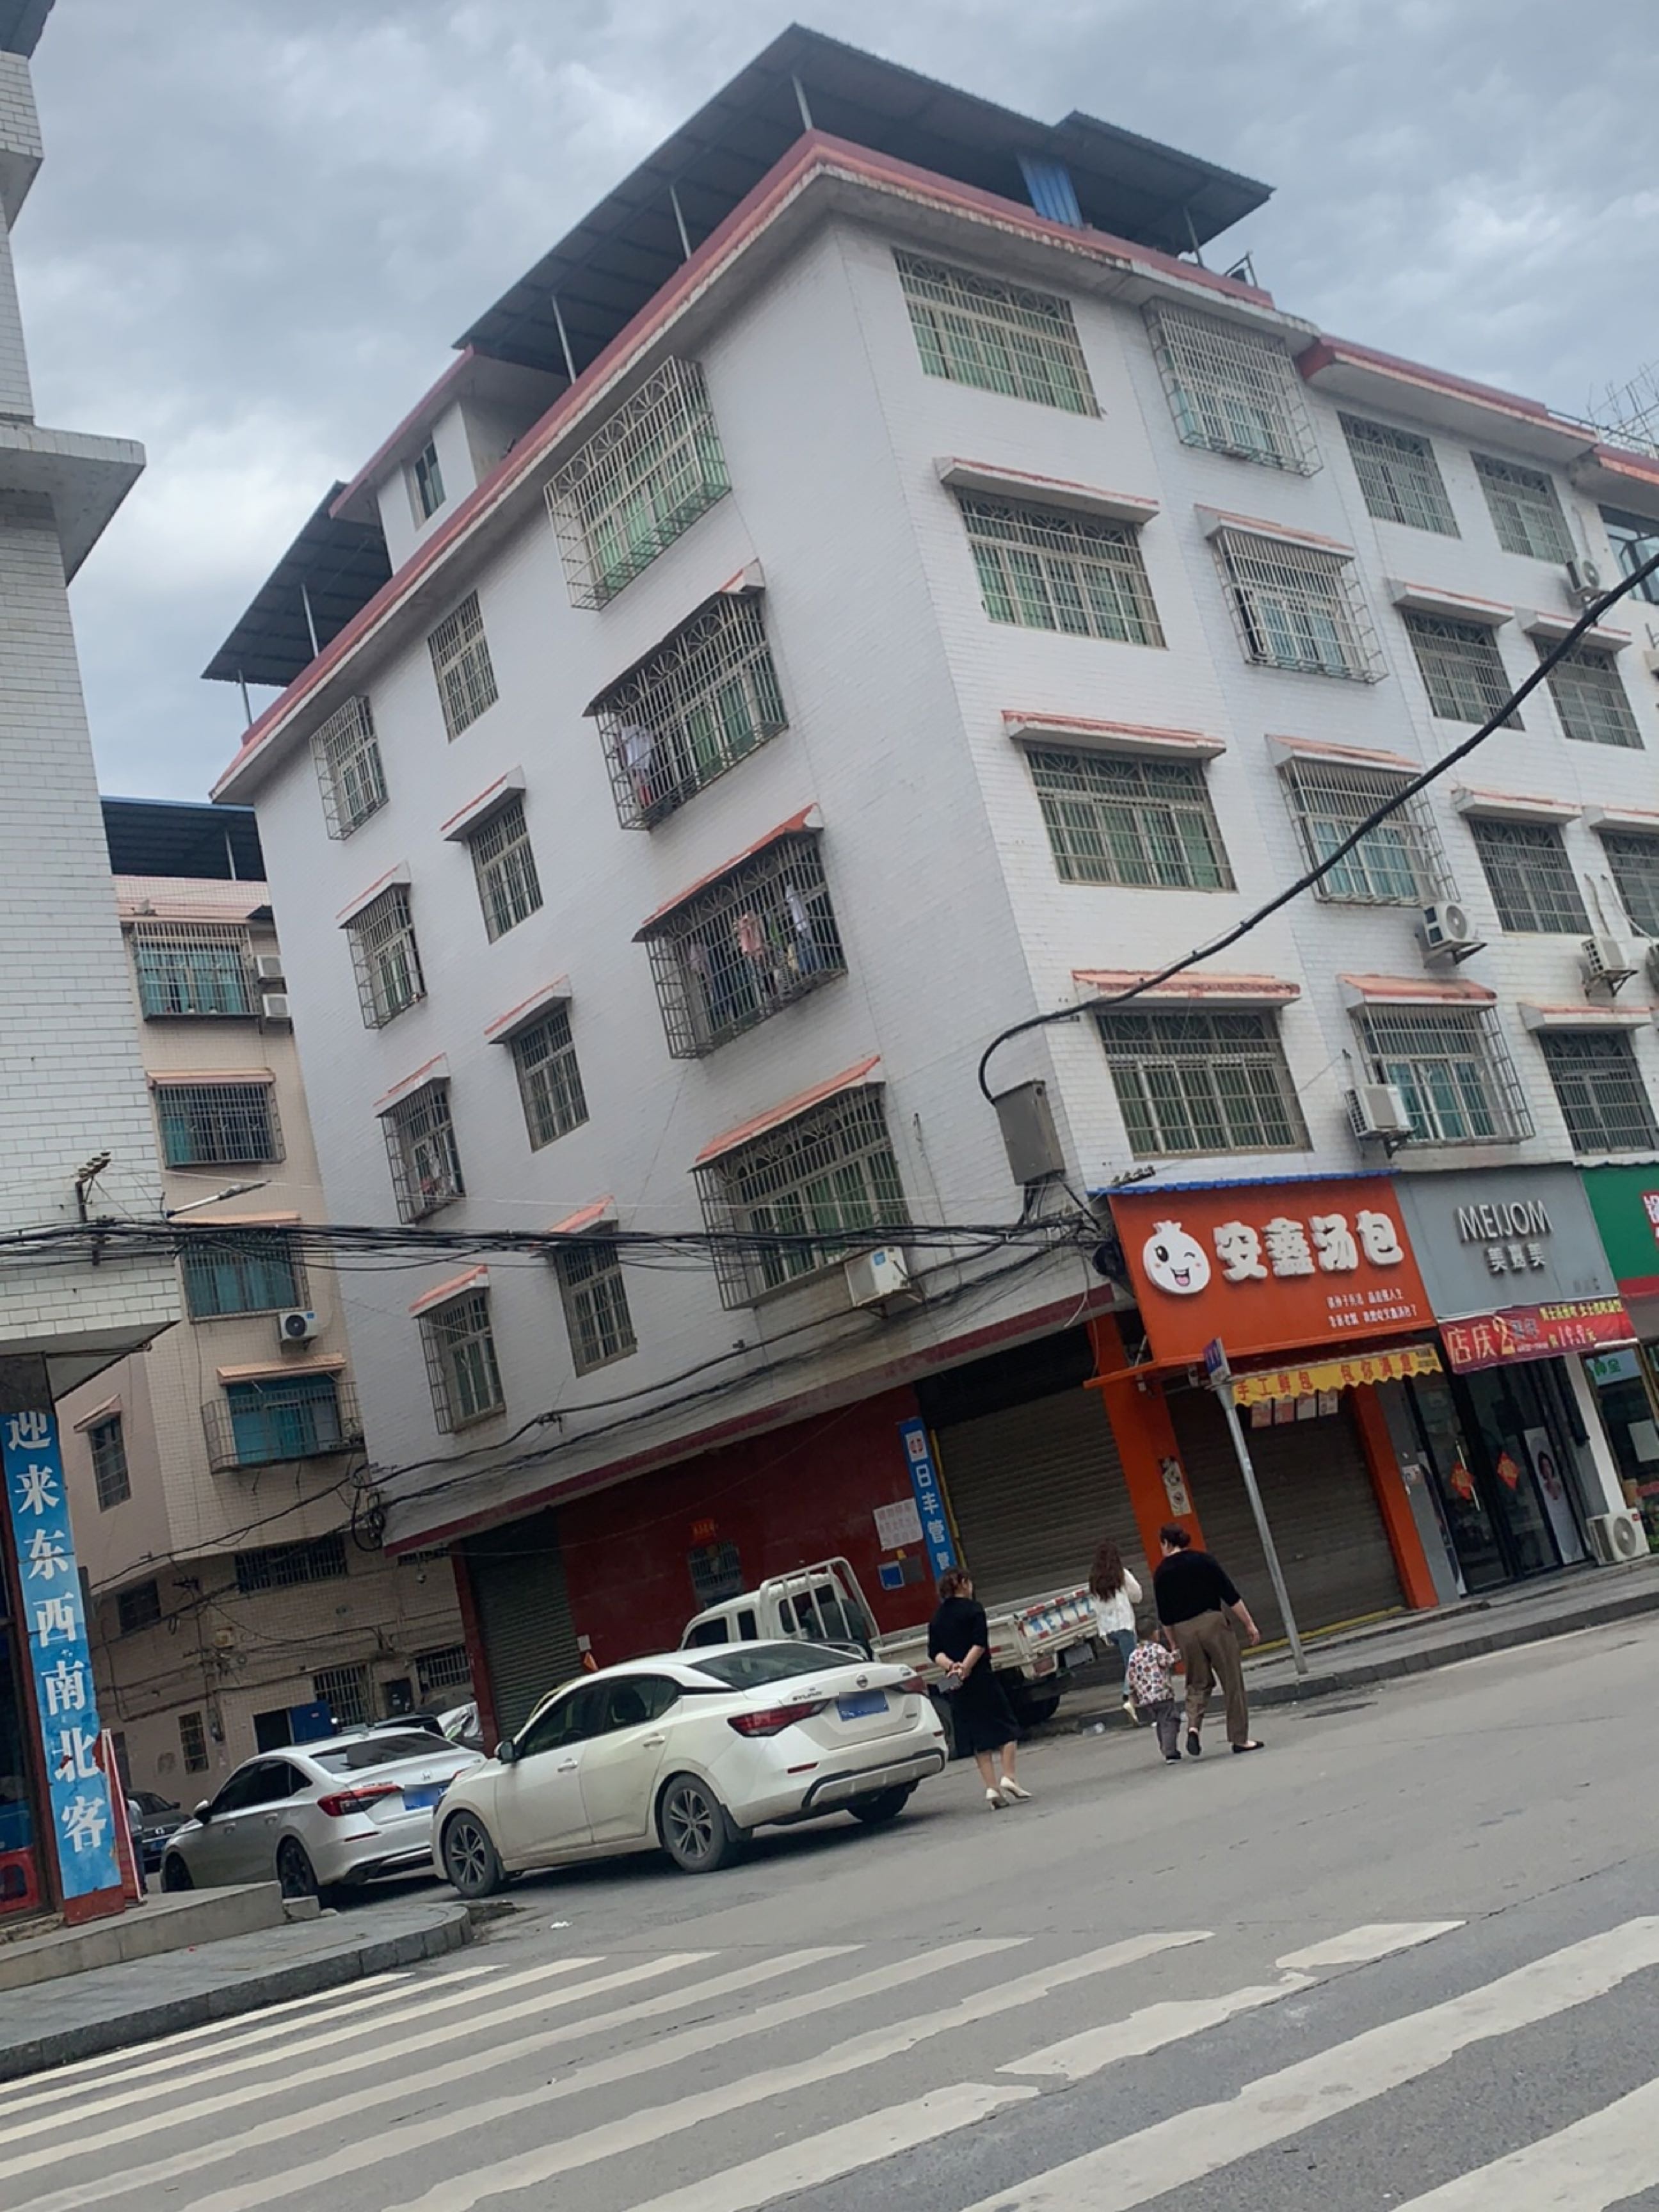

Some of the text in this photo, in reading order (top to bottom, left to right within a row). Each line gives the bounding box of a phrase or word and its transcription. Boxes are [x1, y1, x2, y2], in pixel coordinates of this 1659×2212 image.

[1214, 1209, 1404, 1281] 安鑫汤包
[1457, 1199, 1553, 1241] MEIJOM
[8, 1412, 107, 1853] 迎来东西南北客
